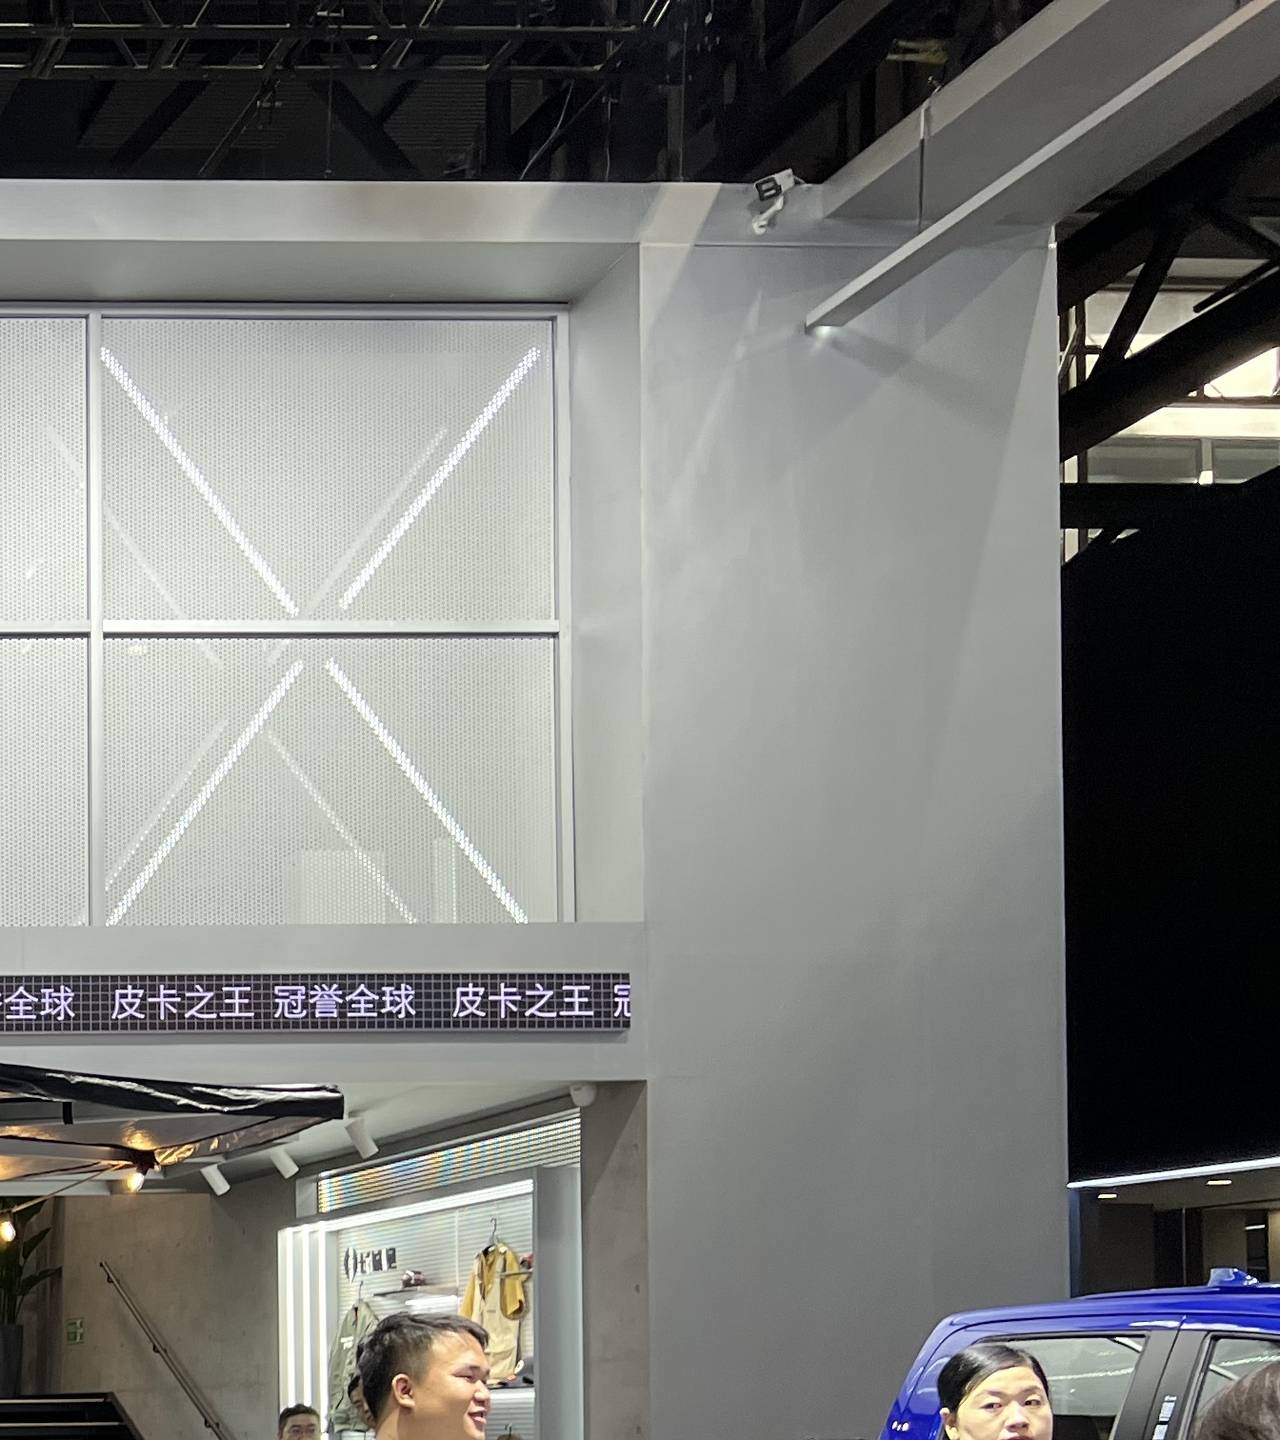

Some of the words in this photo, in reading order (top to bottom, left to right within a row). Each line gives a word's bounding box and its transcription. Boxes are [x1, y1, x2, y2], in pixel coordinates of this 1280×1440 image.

[112, 985, 254, 1020] 皮卡之王
[275, 984, 415, 1018] 冠誉全球
[453, 983, 593, 1018] 皮卡之王
